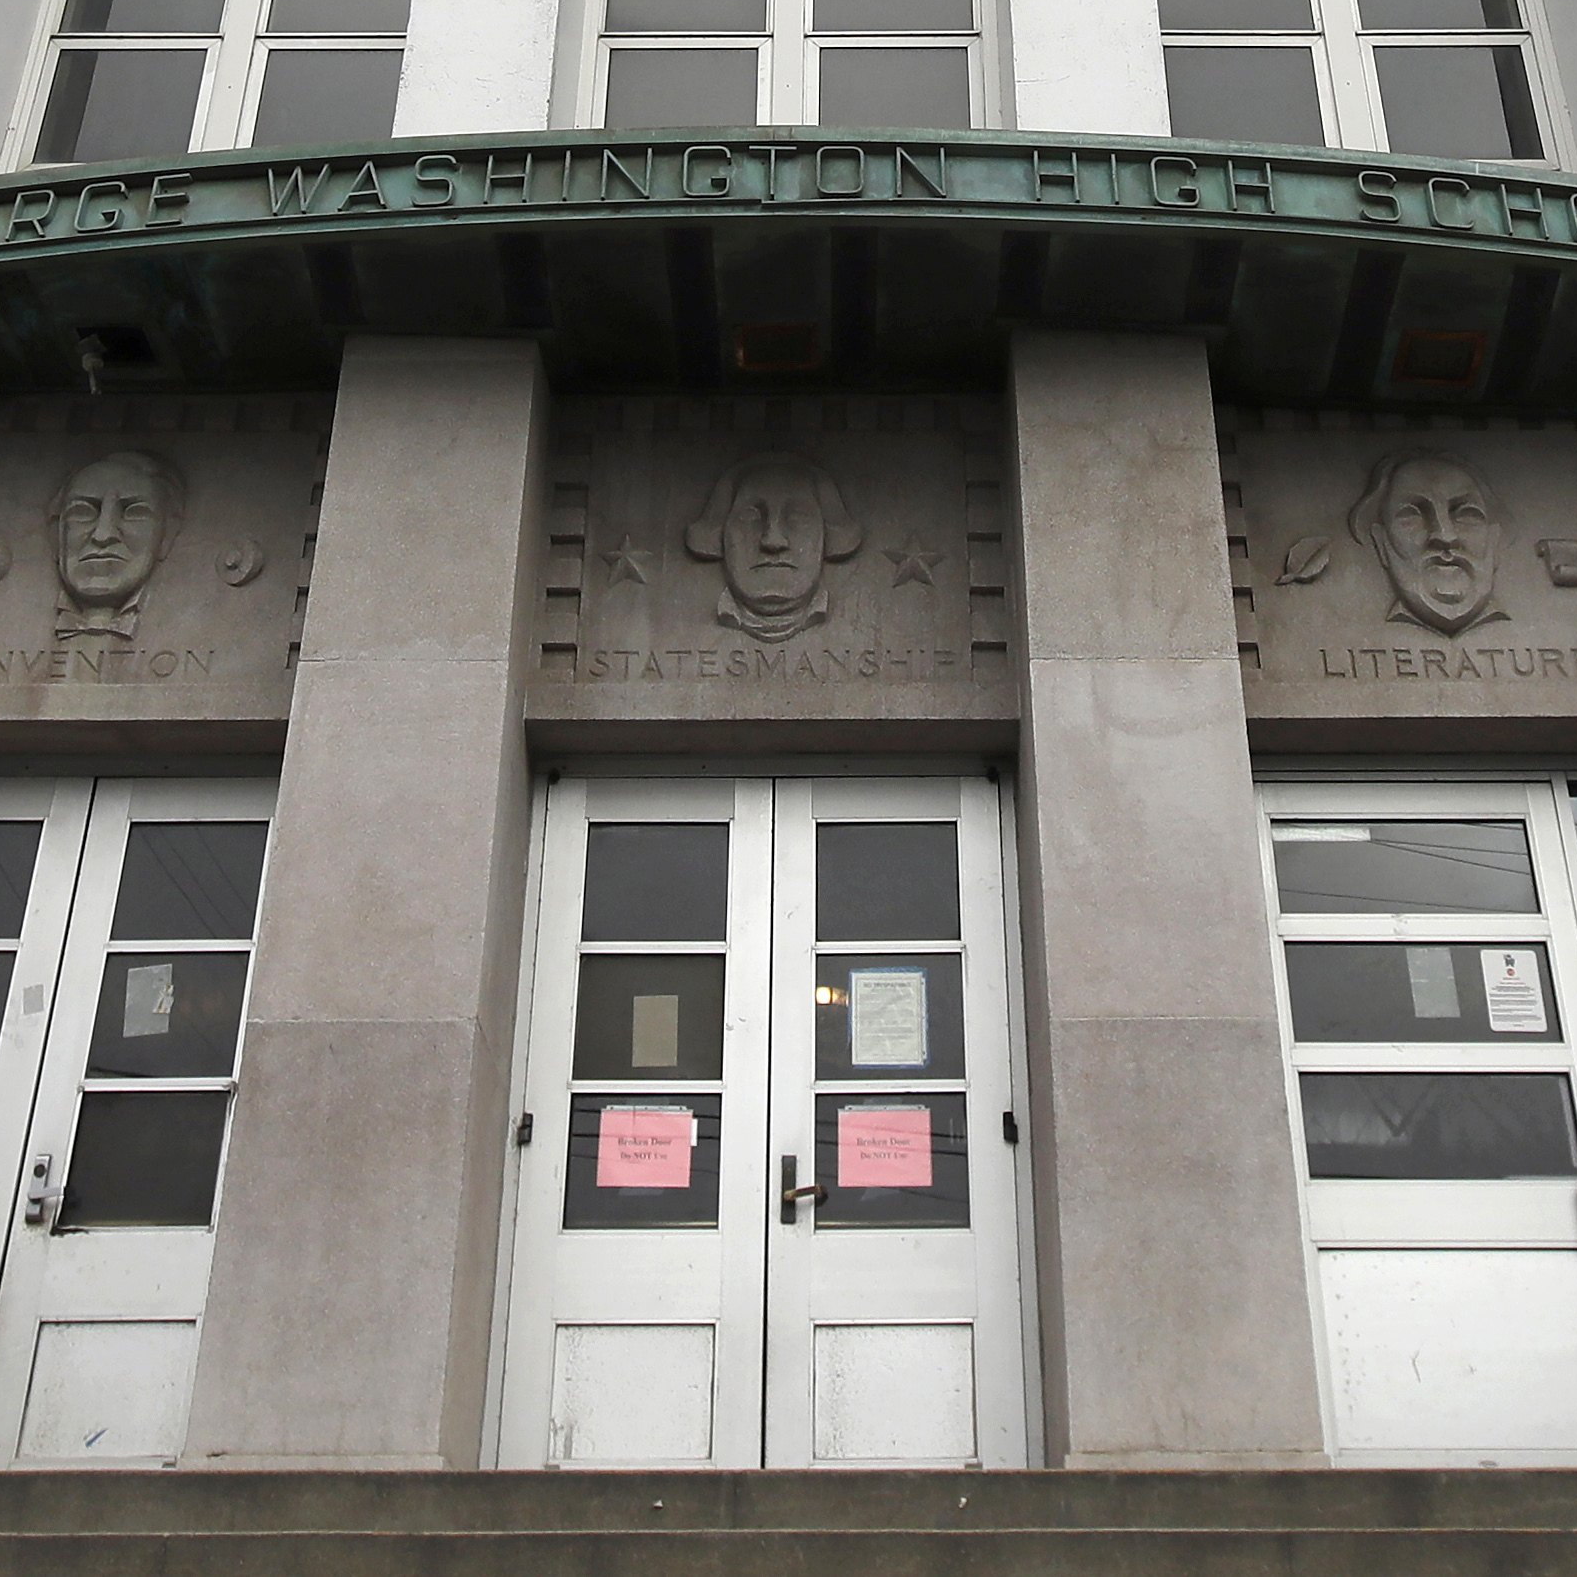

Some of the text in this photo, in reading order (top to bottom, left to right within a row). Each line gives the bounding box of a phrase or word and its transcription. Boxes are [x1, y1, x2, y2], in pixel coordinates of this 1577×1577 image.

[264, 143, 950, 218] WASHINGTON
[1031, 148, 1278, 214] HIGH
[588, 647, 958, 682] STATESMANSHIP
